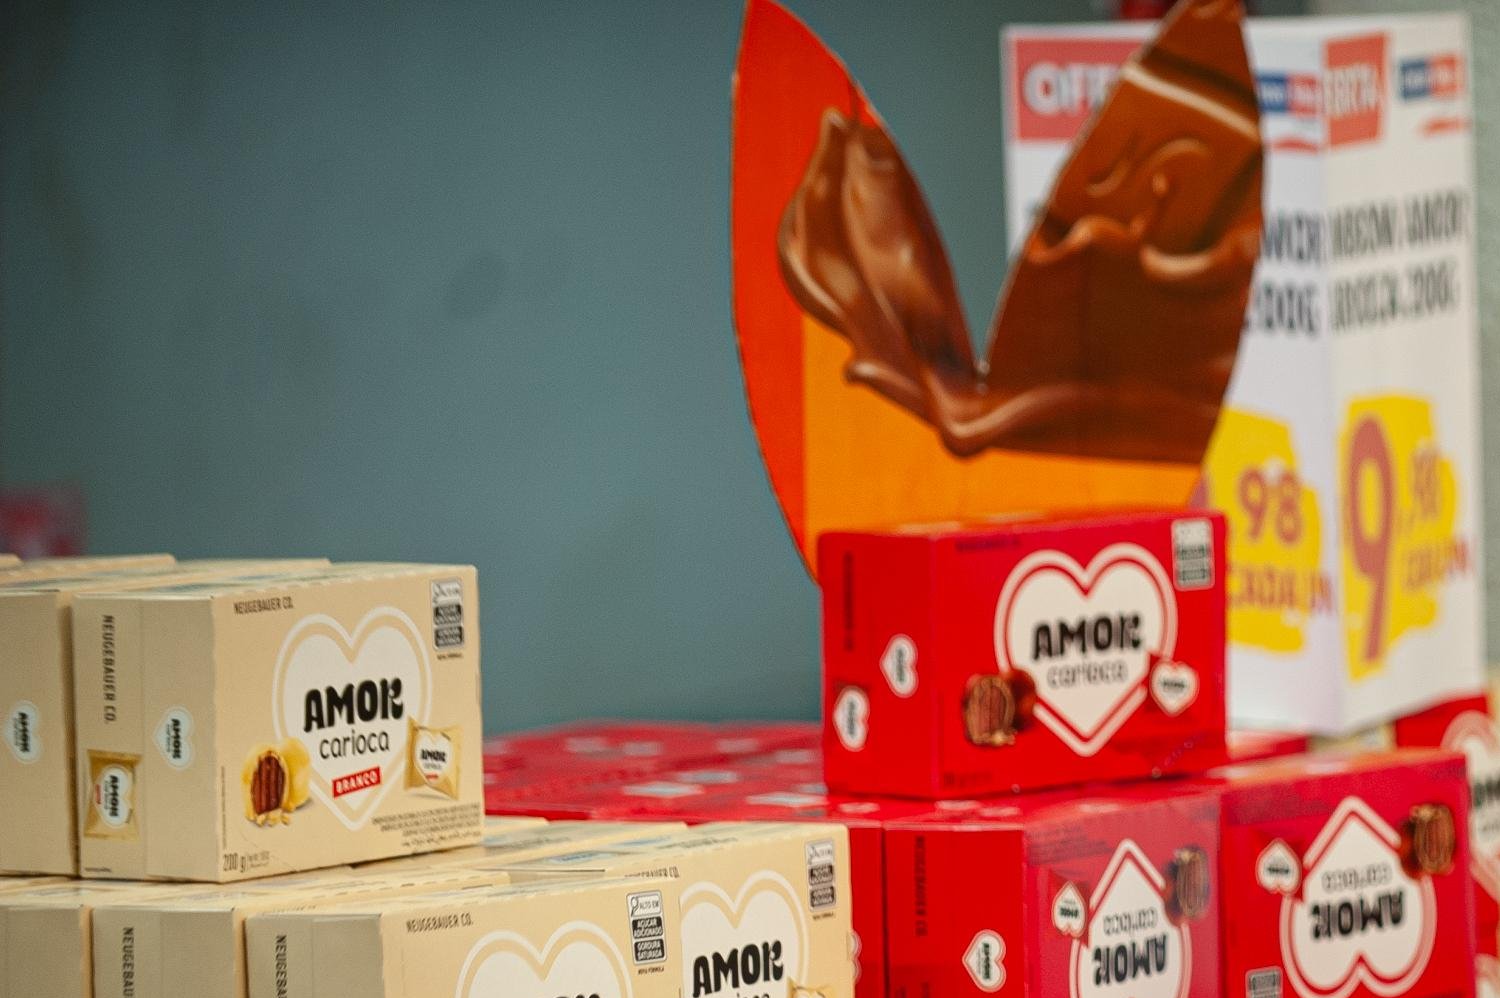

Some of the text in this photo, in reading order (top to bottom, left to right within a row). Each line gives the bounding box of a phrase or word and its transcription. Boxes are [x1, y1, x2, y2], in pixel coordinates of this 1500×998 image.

[1238, 464, 1303, 546] 98
[234, 598, 280, 614] NEUGEBAUER
[103, 614, 115, 702] NEUGEBAUER
[1033, 613, 1141, 661] AMOR
[303, 678, 404, 732] AMOR
[171, 718, 181, 759] AMOR
[320, 727, 390, 760] carioca
[419, 748, 446, 763] AMOR
[109, 775, 119, 817] AMOR
[335, 770, 380, 795] BRANCO
[406, 917, 458, 933] NEUGEBAUER
[1311, 891, 1403, 941] AMOR
[693, 940, 784, 998] AMOR
[1094, 934, 1167, 986] AMOR
